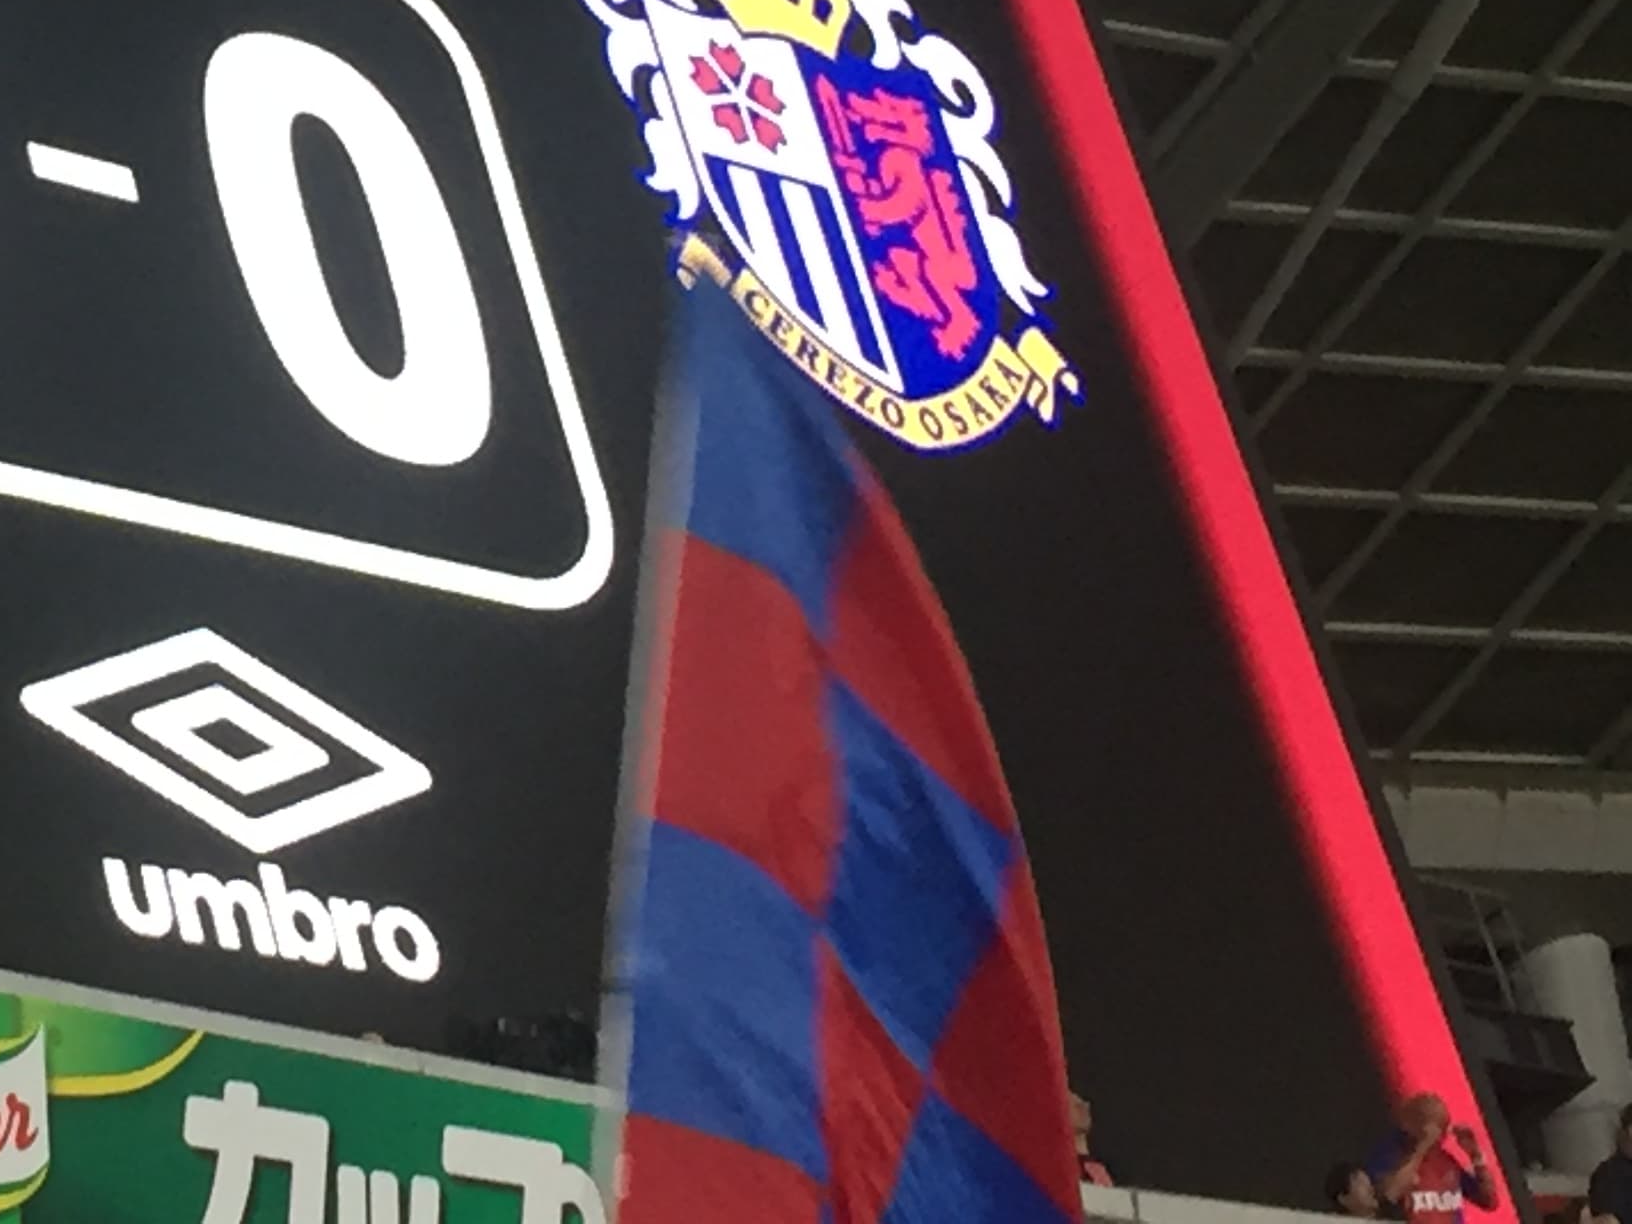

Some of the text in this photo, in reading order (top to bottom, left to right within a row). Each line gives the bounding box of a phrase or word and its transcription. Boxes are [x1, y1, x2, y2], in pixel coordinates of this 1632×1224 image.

[744, 288, 1024, 442] CEREZO OSAKA
[101, 856, 441, 983] umbro
